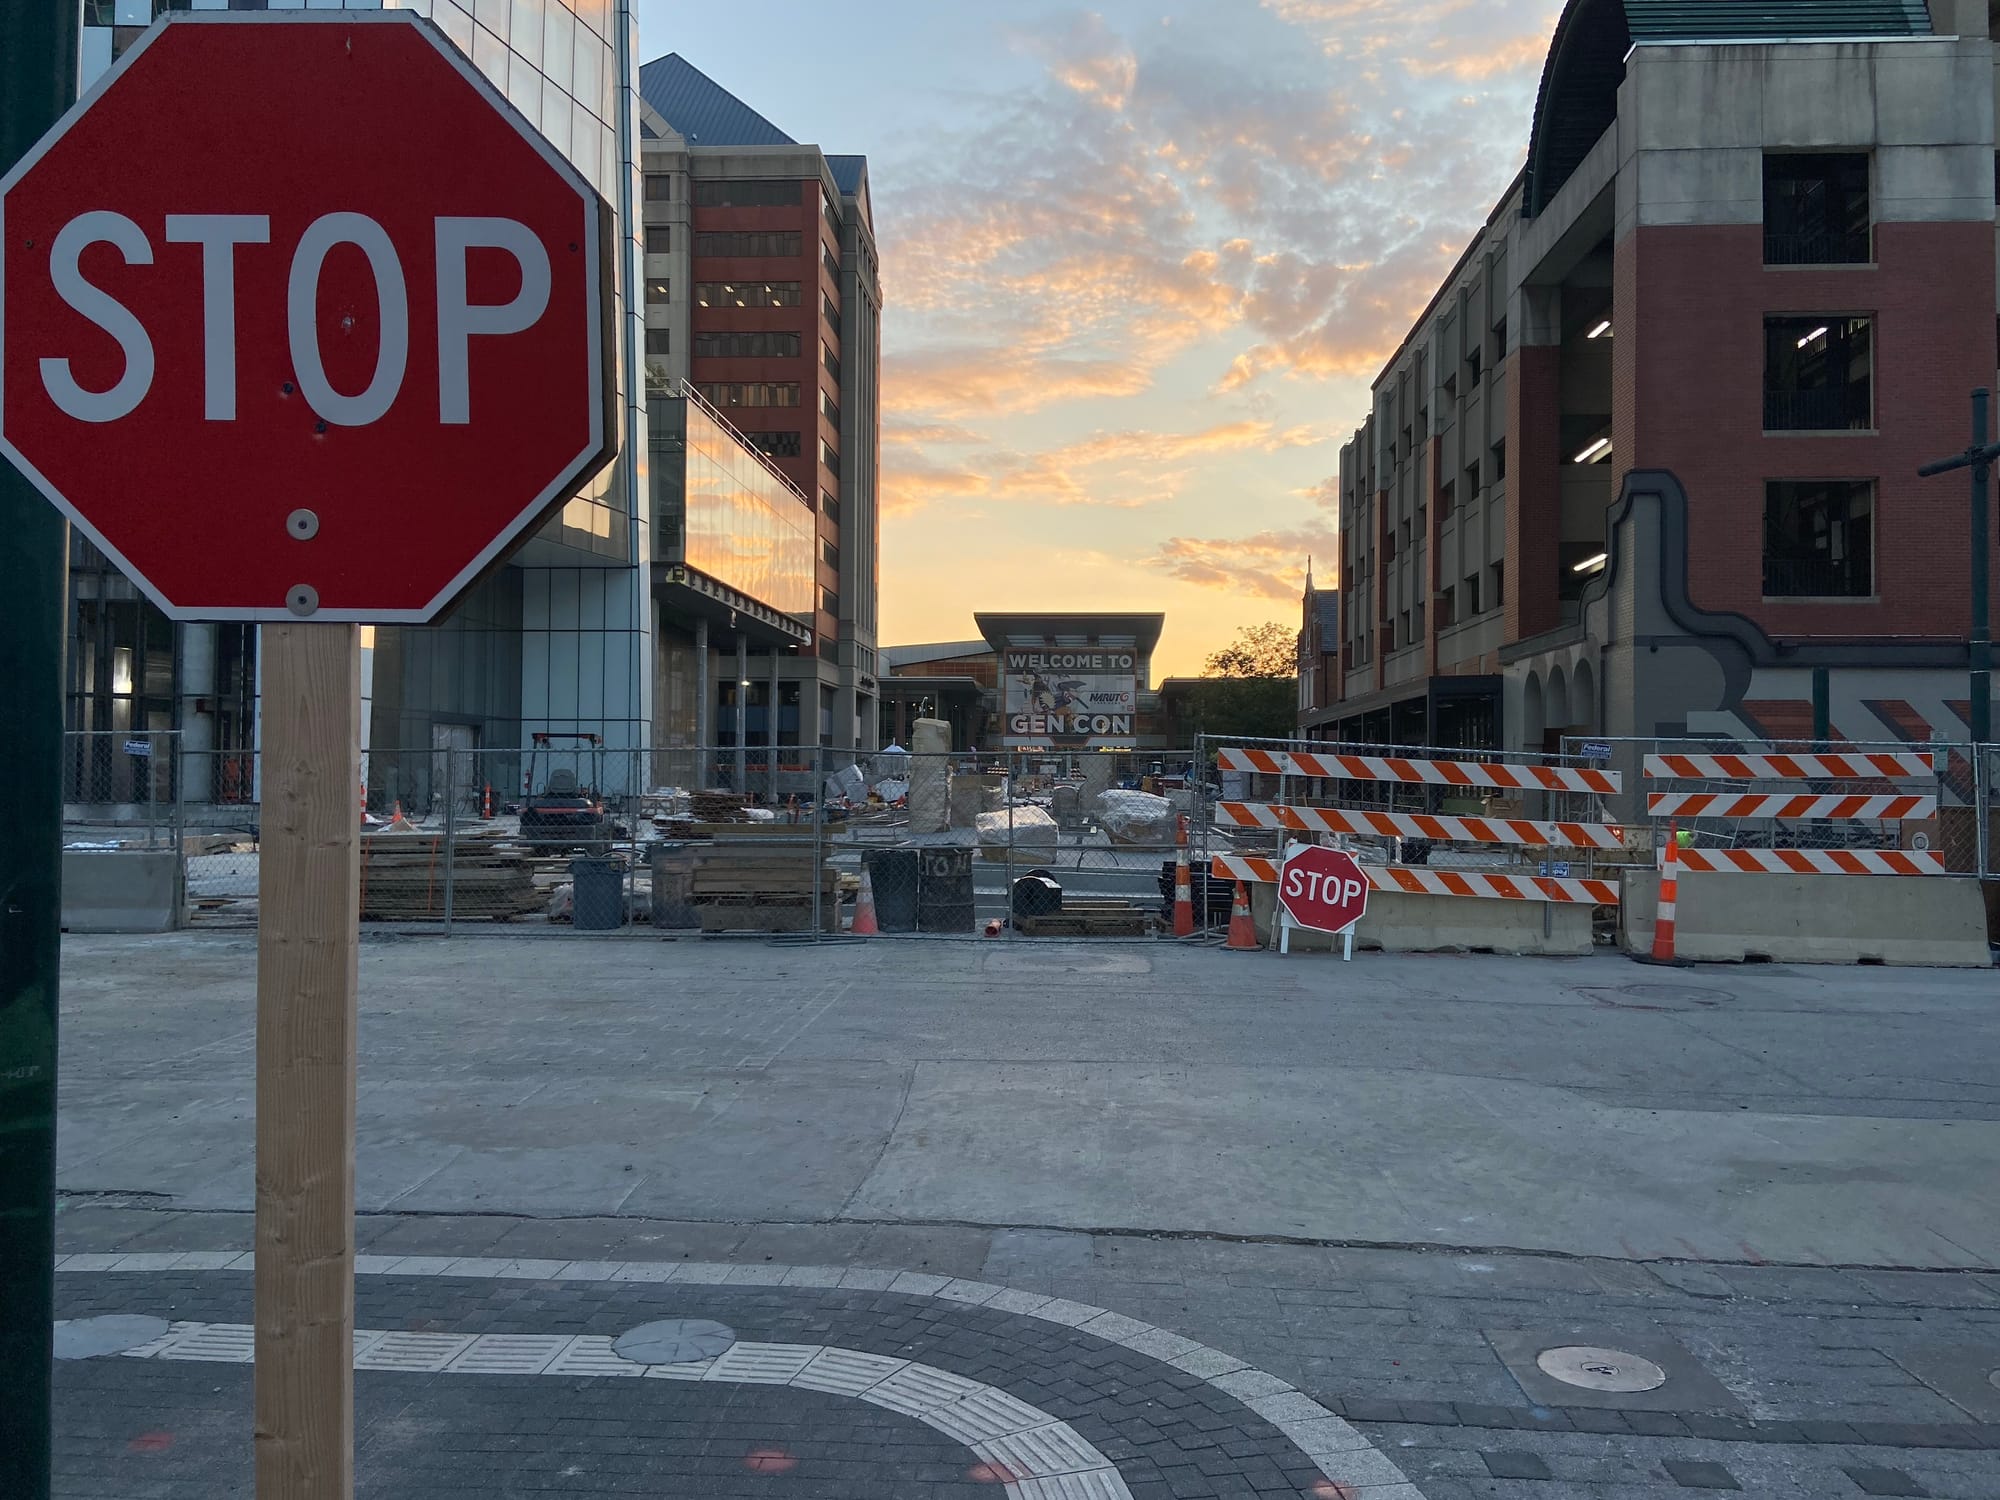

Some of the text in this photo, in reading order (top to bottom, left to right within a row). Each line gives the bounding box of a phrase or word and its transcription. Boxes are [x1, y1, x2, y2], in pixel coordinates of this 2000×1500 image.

[39, 210, 552, 427] STOP
[1009, 654, 1132, 668] WELCOME TO
[1089, 691, 1129, 703] NARUTO
[1010, 714, 1130, 734] GEN CON
[1583, 743, 1610, 752] Federal
[1285, 868, 1362, 908] STOP
